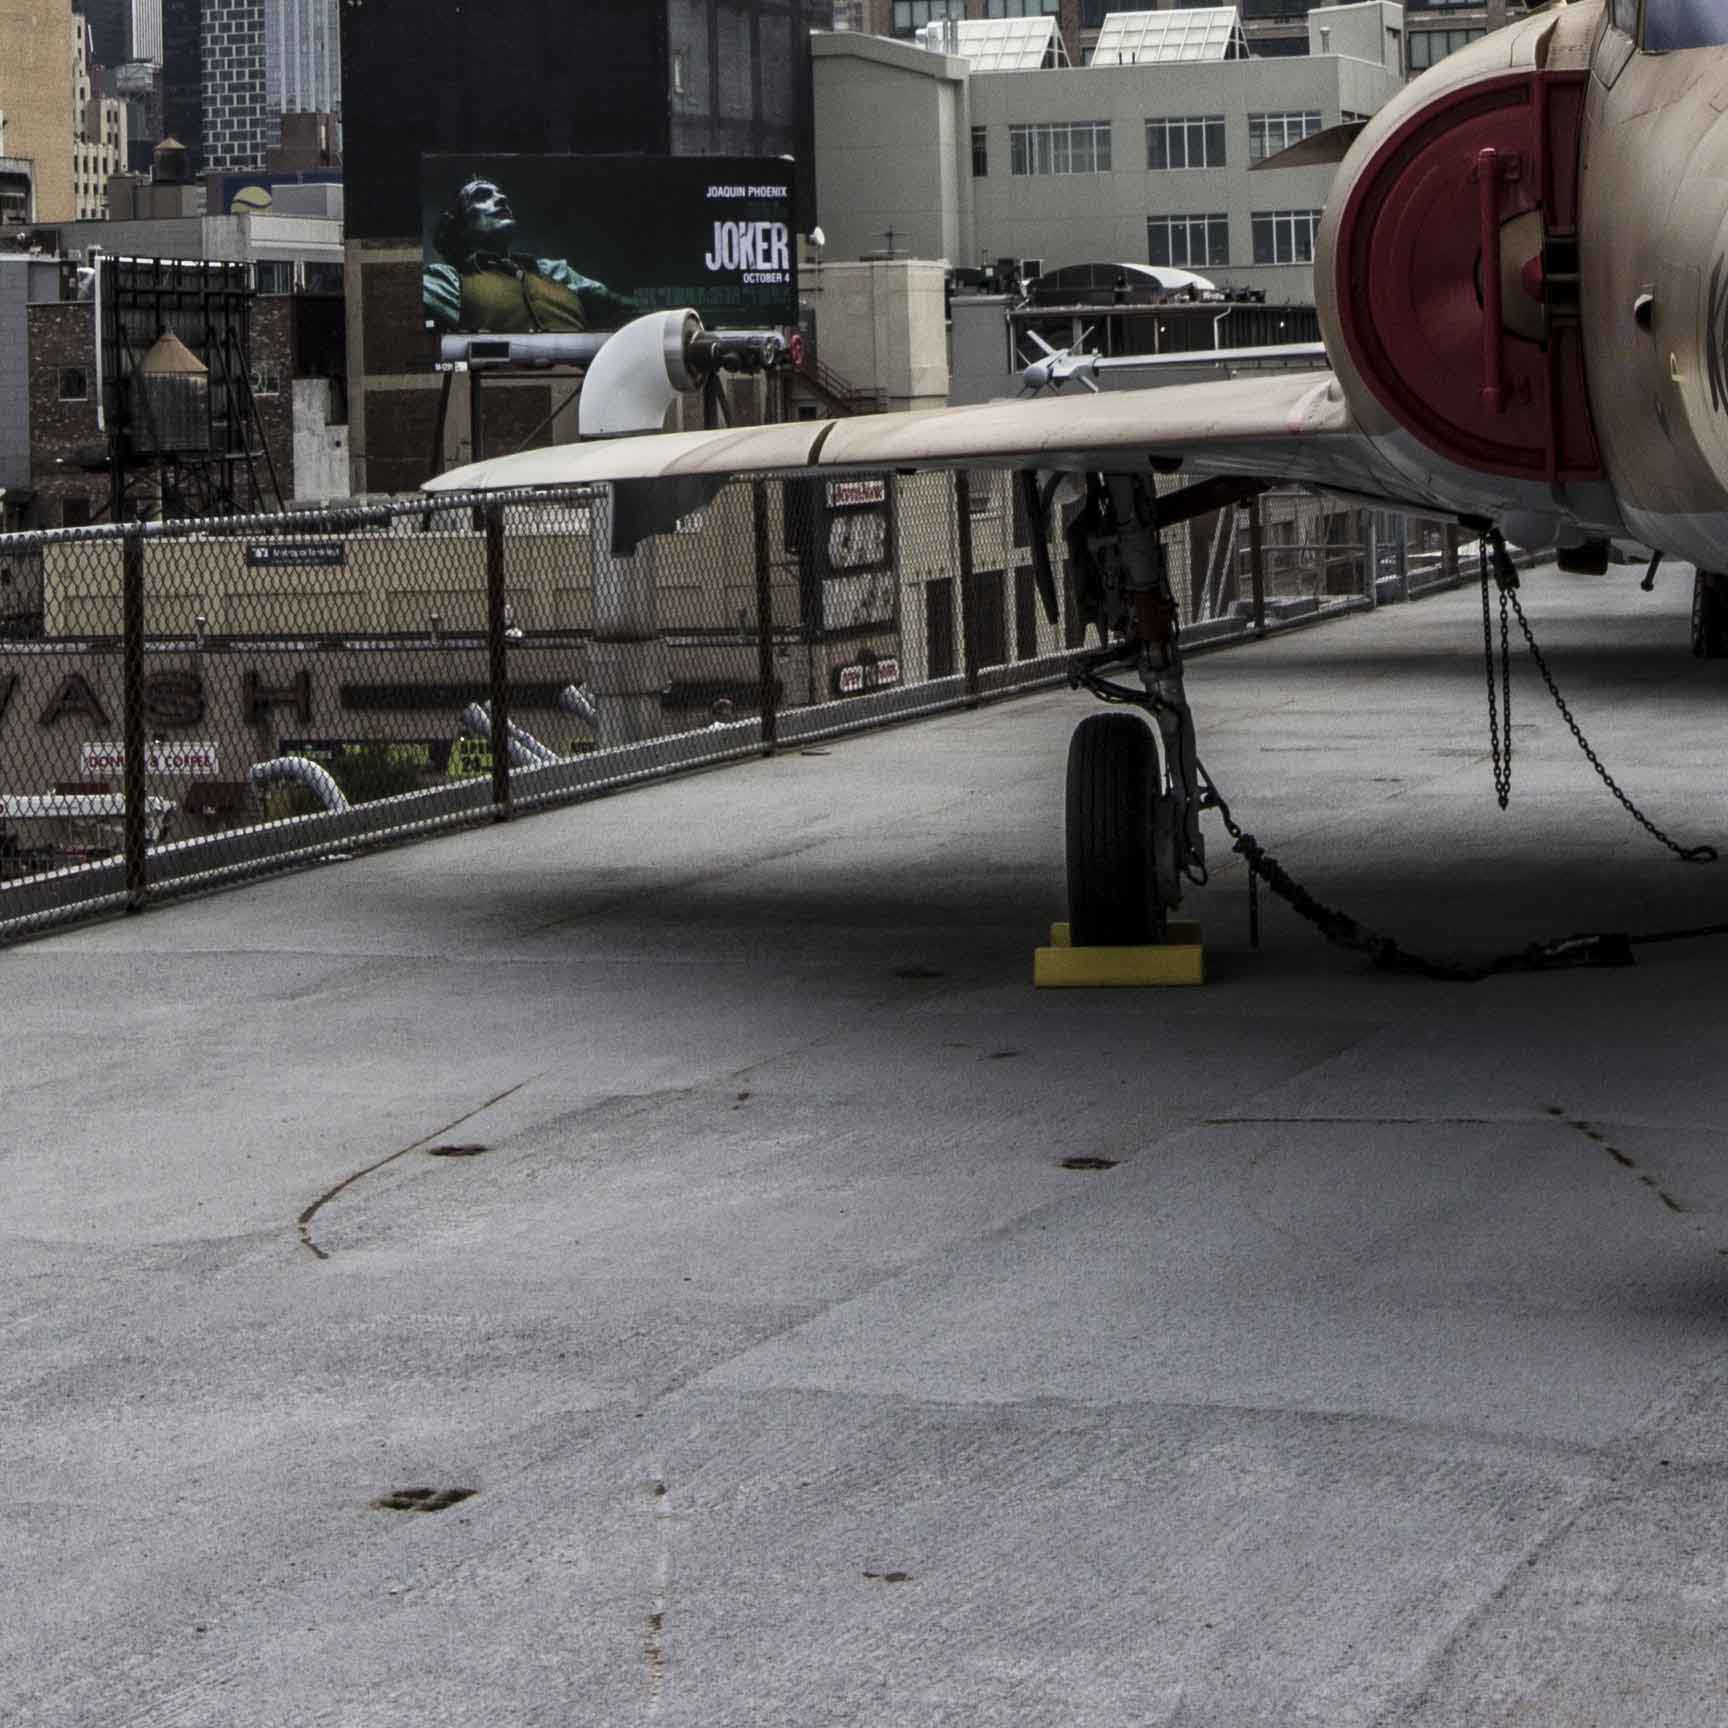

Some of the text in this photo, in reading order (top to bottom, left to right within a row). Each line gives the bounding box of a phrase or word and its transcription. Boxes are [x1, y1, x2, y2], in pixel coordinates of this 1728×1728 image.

[706, 185, 787, 198] JOAQUIN PHOENIX
[704, 220, 790, 271] JOKER
[743, 272, 790, 284] OCTOBER 4
